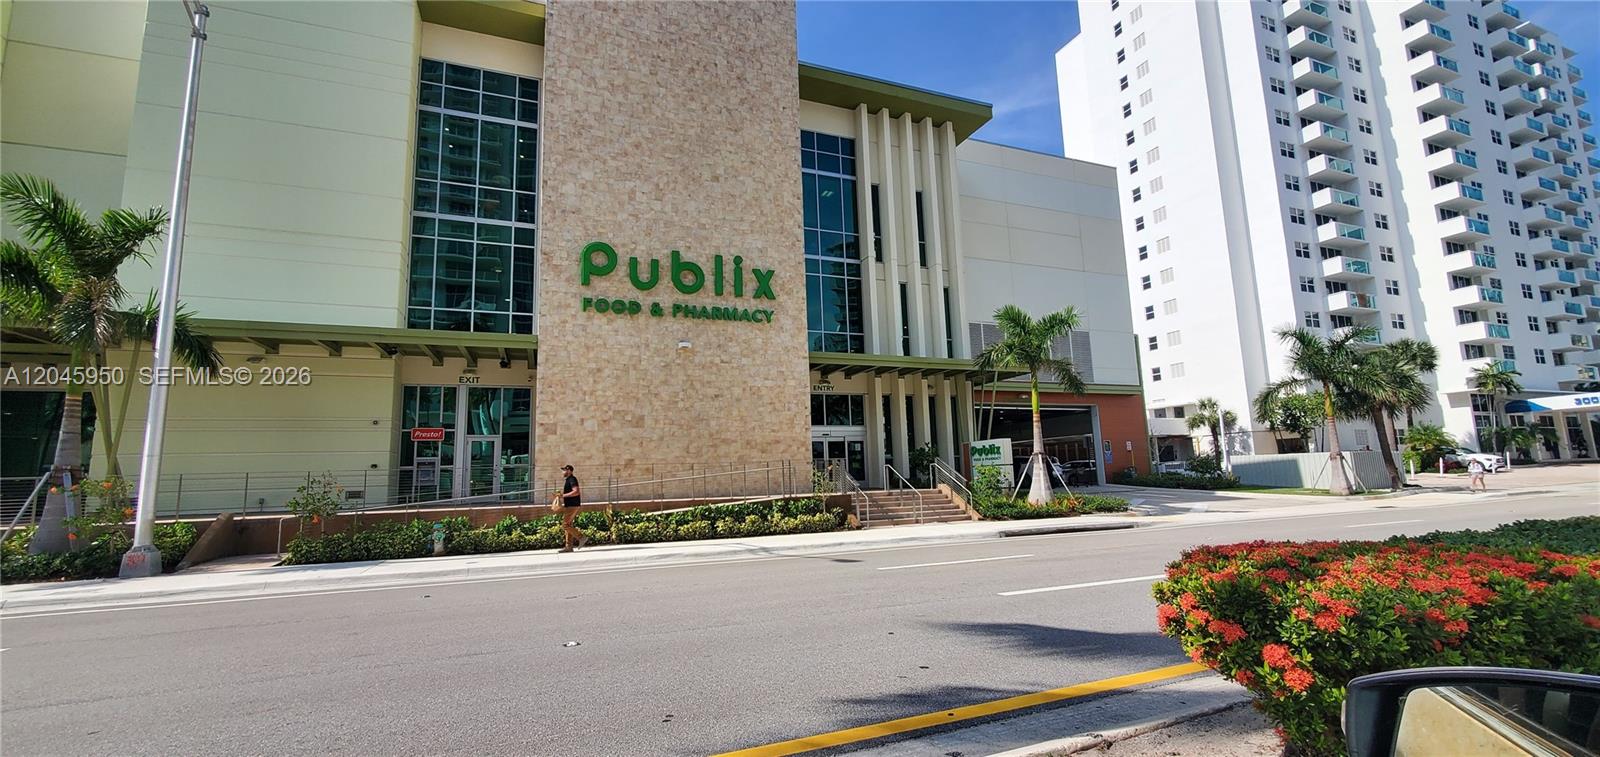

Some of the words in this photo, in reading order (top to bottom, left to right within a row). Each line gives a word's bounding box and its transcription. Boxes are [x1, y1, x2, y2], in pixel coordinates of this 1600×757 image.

[581, 241, 776, 300] Publix
[582, 297, 642, 315] FOOD
[650, 302, 664, 317] &
[672, 303, 775, 324] PHARMACY
[458, 376, 481, 384] EXIT
[971, 444, 1001, 456] Publix
